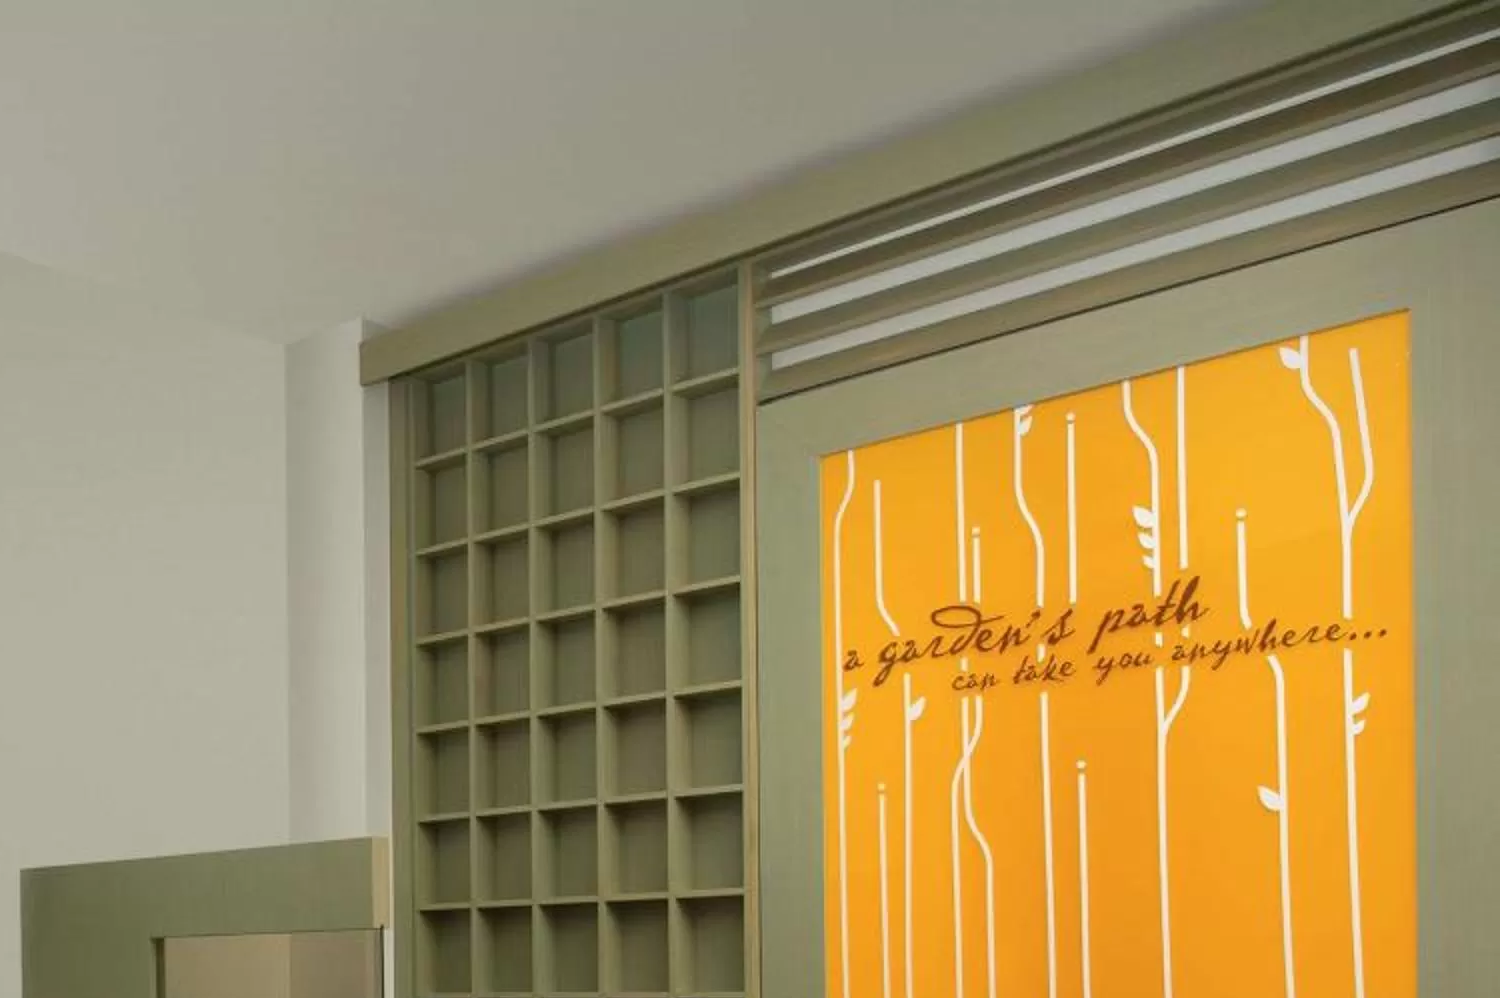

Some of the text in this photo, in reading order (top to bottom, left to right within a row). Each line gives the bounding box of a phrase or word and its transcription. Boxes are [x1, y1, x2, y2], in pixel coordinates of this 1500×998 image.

[842, 575, 1211, 688] a garden's path
[951, 617, 1389, 691] can take you anywhere...
